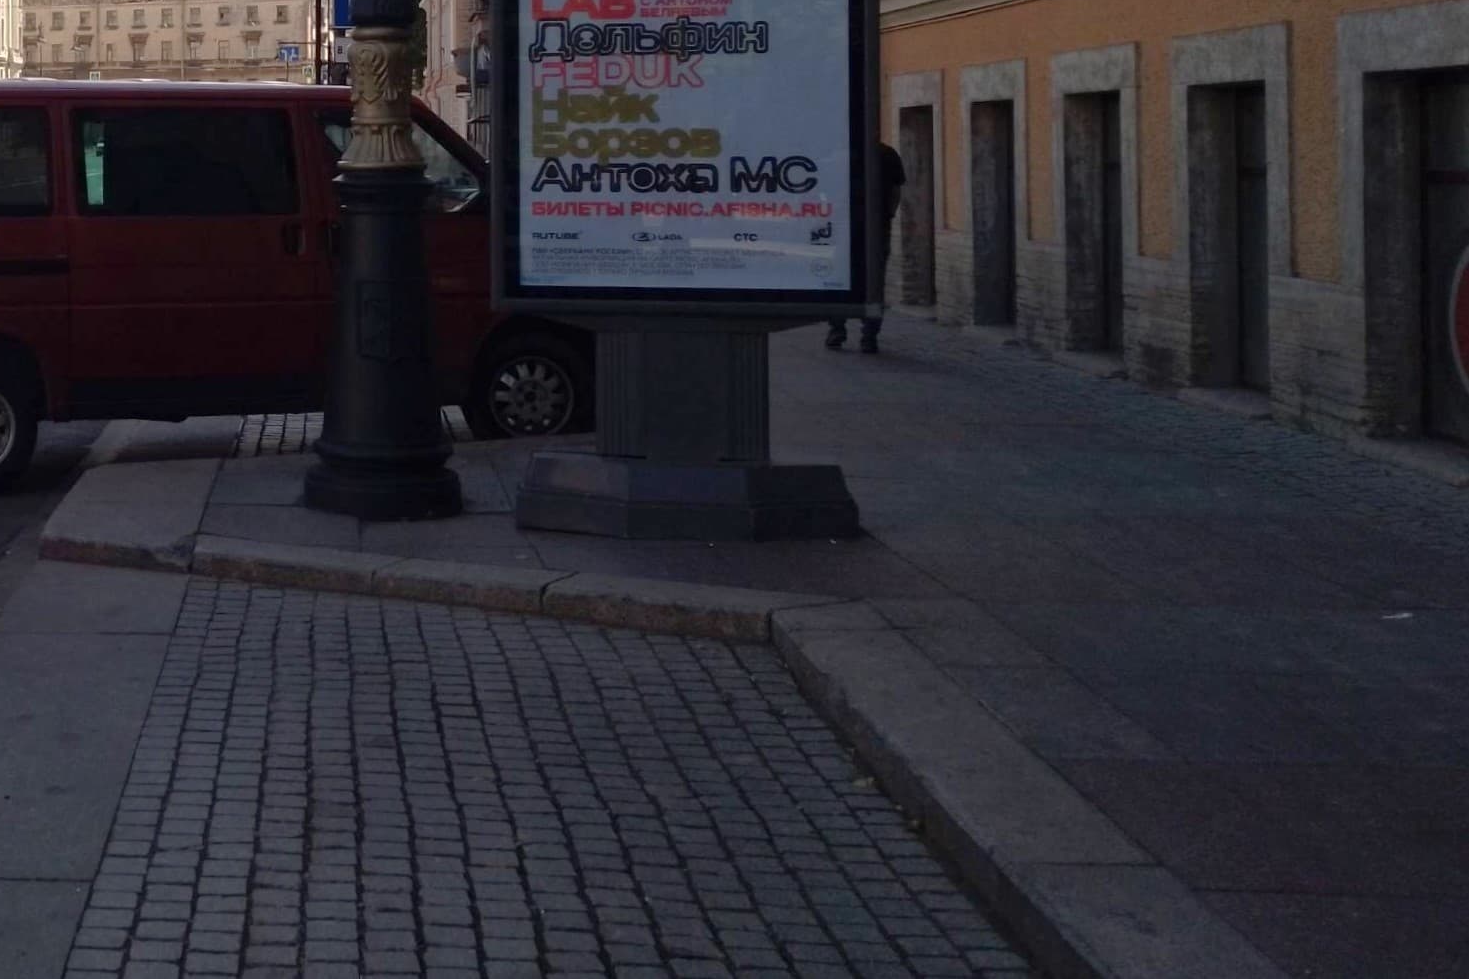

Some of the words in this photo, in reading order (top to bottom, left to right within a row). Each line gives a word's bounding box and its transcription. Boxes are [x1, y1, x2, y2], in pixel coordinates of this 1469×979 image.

[529, 15, 769, 62] Дольфин
[531, 53, 705, 89] FEDUK
[532, 122, 722, 166] Борзов
[531, 157, 719, 193] Антоха
[531, 201, 624, 216] БИЛЕТЫ
[631, 202, 832, 217] PICNIC.AFISHA.RU
[532, 232, 580, 240] RUTUBE
